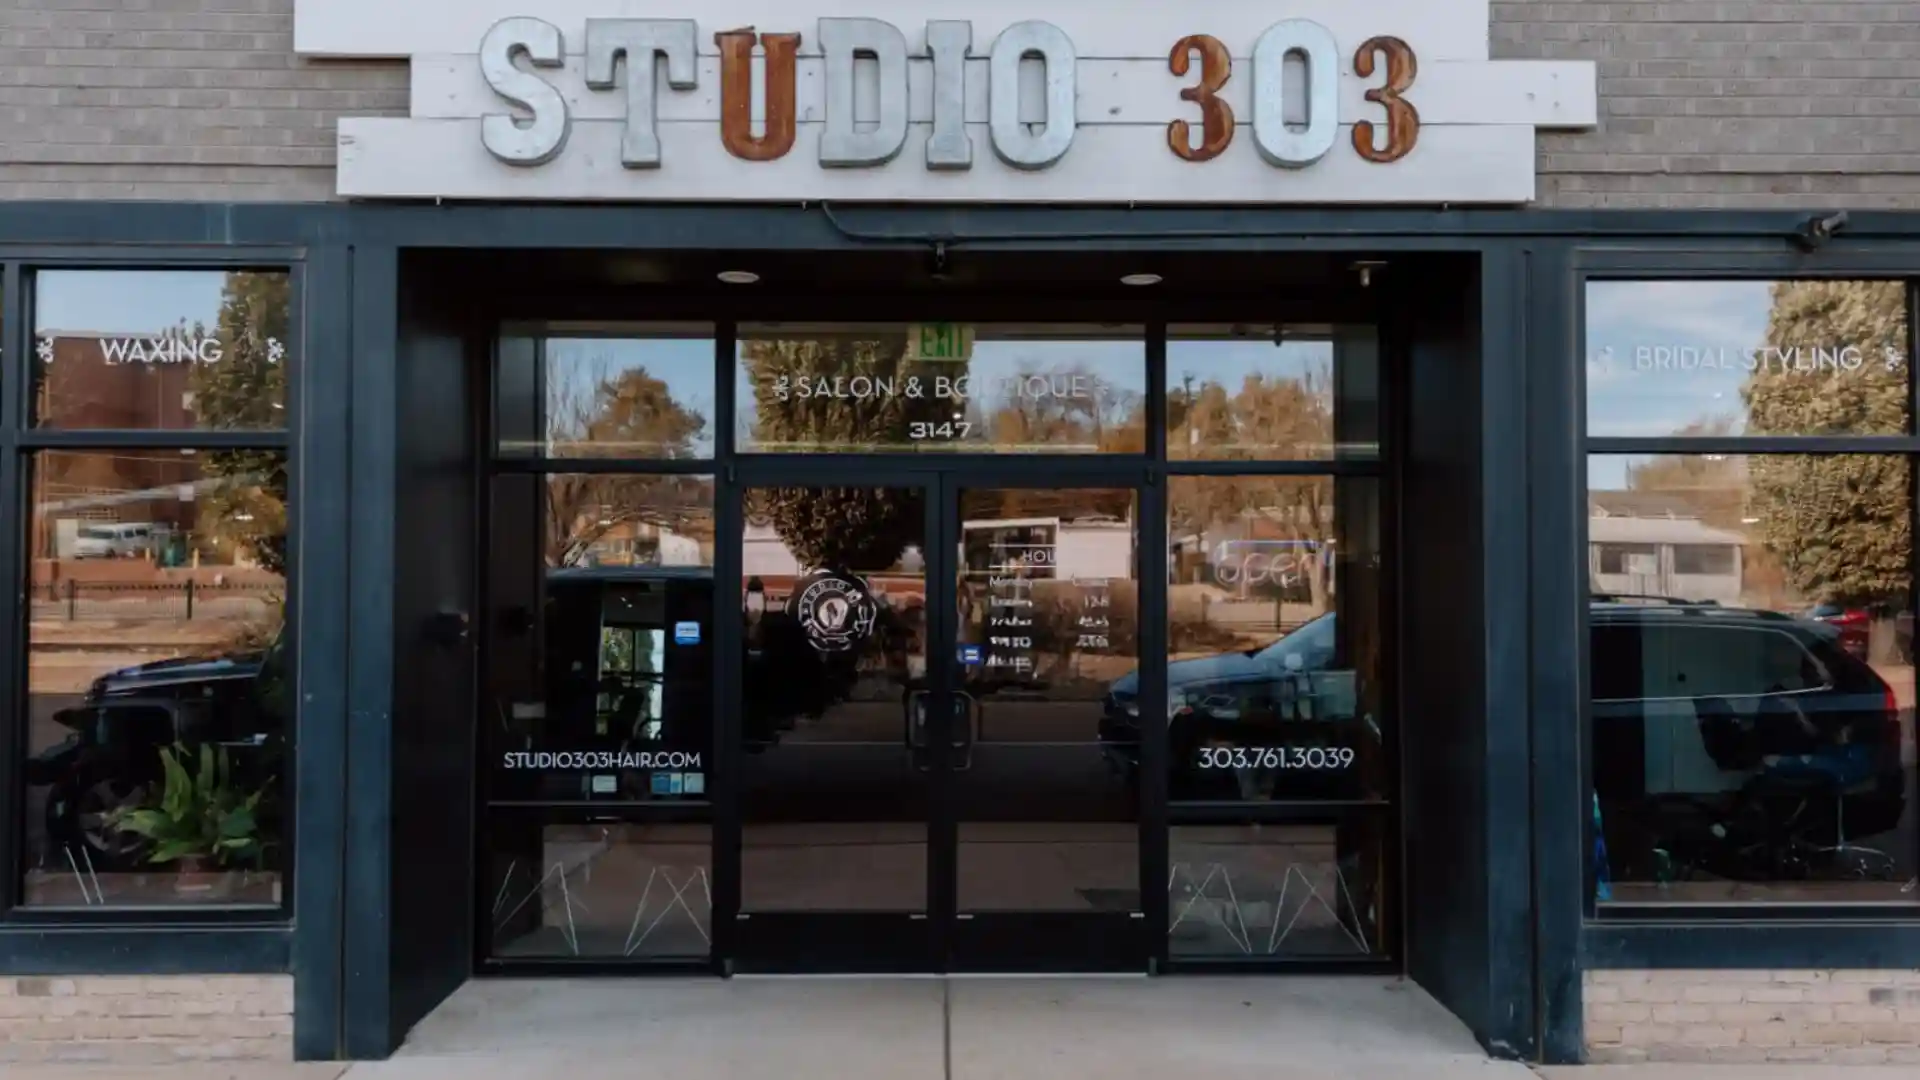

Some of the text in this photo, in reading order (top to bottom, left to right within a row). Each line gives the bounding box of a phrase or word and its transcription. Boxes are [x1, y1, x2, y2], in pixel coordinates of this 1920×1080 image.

[478, 16, 1420, 170] STUDIO 303
[100, 338, 223, 363] WAXING
[1636, 346, 1863, 371] BRIDAL STYLING
[798, 376, 893, 398] SALON
[904, 376, 924, 398] &
[909, 422, 972, 438] 3147
[504, 751, 701, 769] STUDIO303HAIR.COM
[1198, 748, 1355, 769] 303.761.3039
